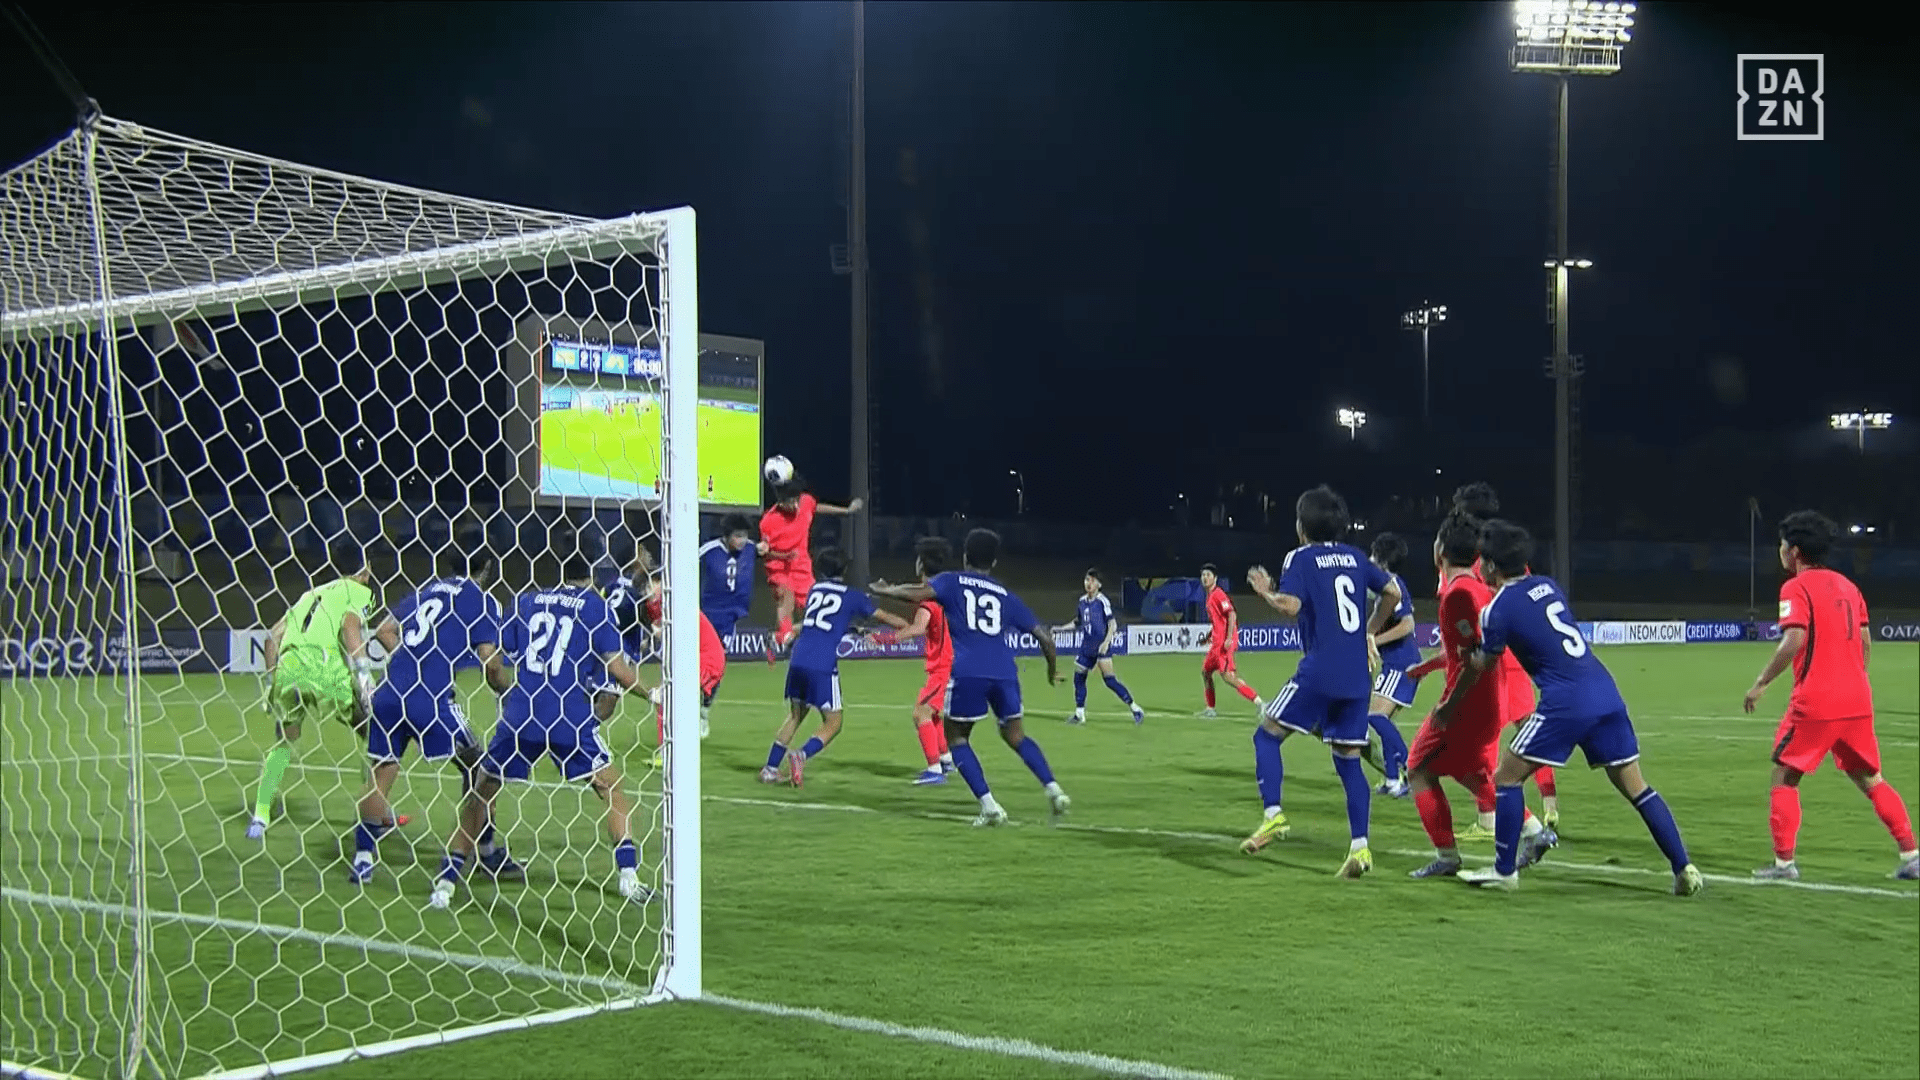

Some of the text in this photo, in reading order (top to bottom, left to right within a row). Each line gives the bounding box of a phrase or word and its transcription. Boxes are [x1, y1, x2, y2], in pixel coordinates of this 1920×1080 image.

[301, 595, 322, 633] 1
[803, 591, 842, 632] 22
[963, 588, 1002, 636] 13
[1334, 574, 1361, 634] 6
[1020, 633, 1040, 649] CU
[1137, 632, 1173, 645] NEOM
[1237, 628, 1301, 647] CREDIT SAI
[1545, 600, 1587, 659] 5
[1629, 624, 1682, 640] NEOM.COM
[1686, 623, 1741, 639] CREDIT SAISON
[526, 611, 574, 677] 21
[1374, 673, 1386, 691] 8
